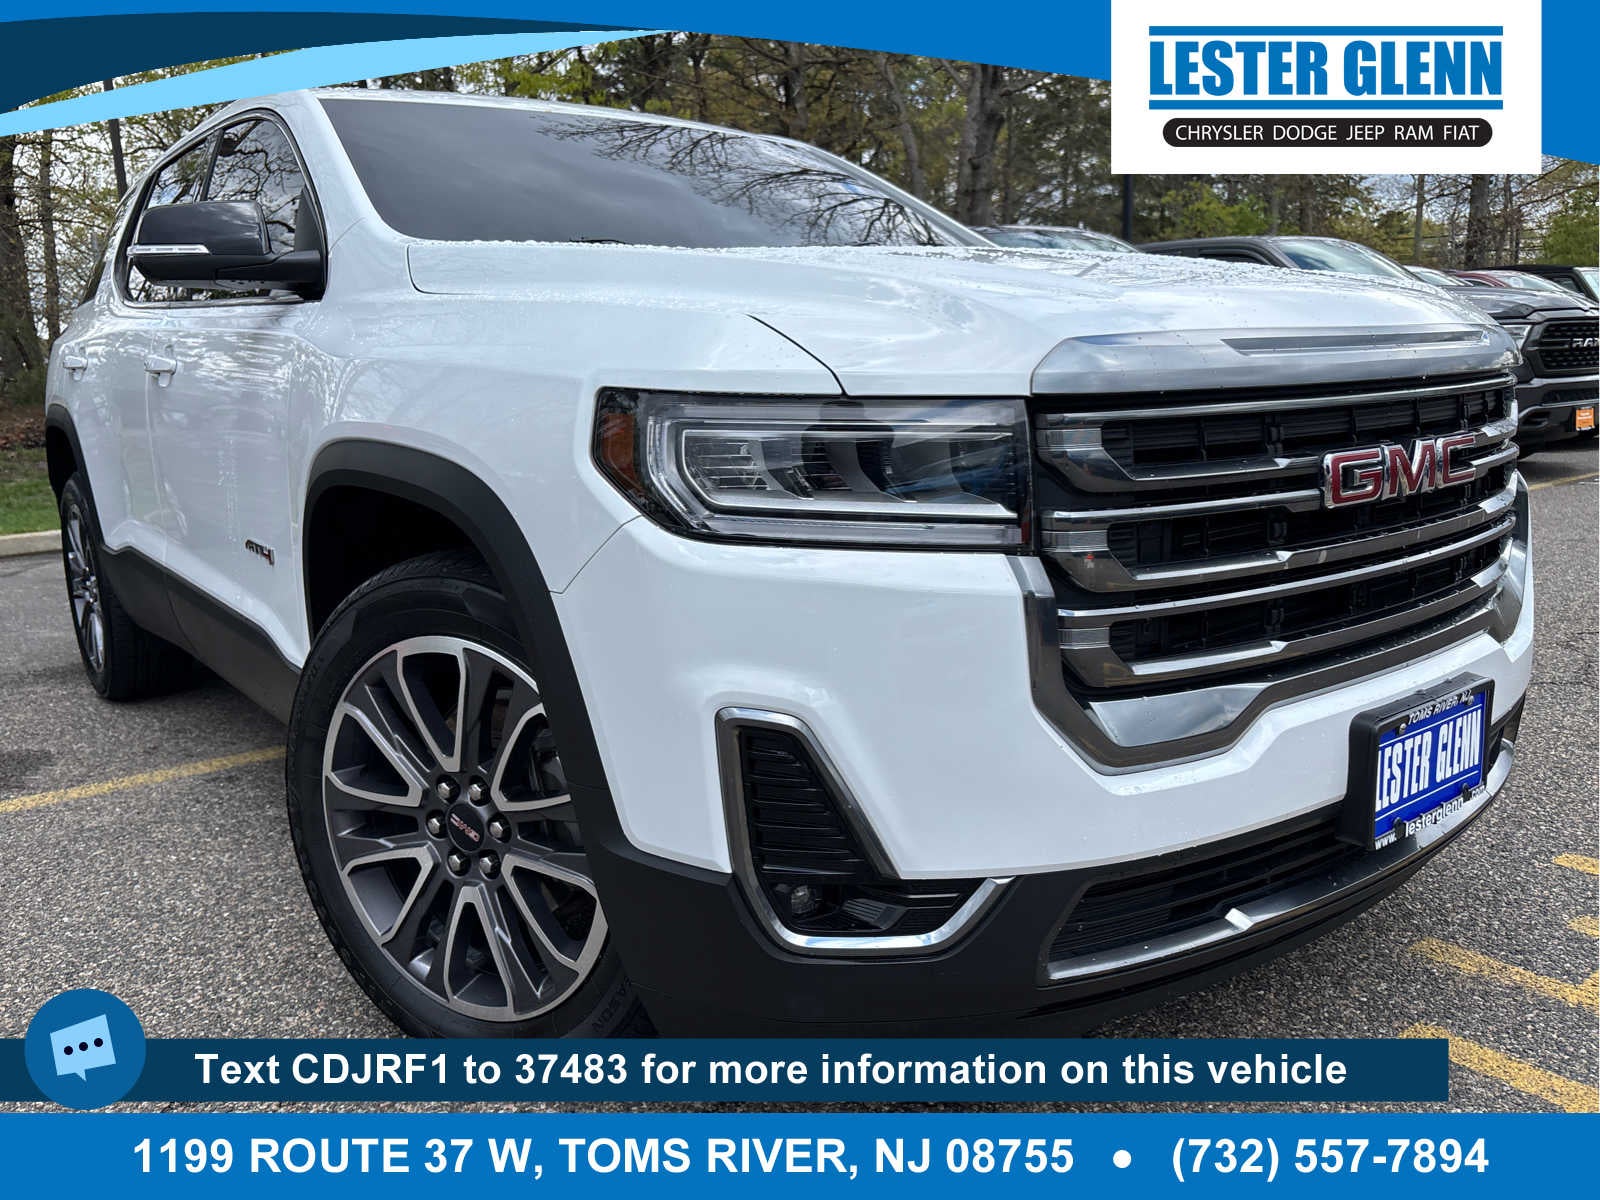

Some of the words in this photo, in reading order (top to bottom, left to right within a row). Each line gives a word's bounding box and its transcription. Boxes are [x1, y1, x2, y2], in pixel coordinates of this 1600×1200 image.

[1324, 433, 1476, 508] GMC
[1408, 706, 1433, 725] TOMS
[1376, 731, 1432, 812] LESTER
[1435, 709, 1482, 783] GLENN
